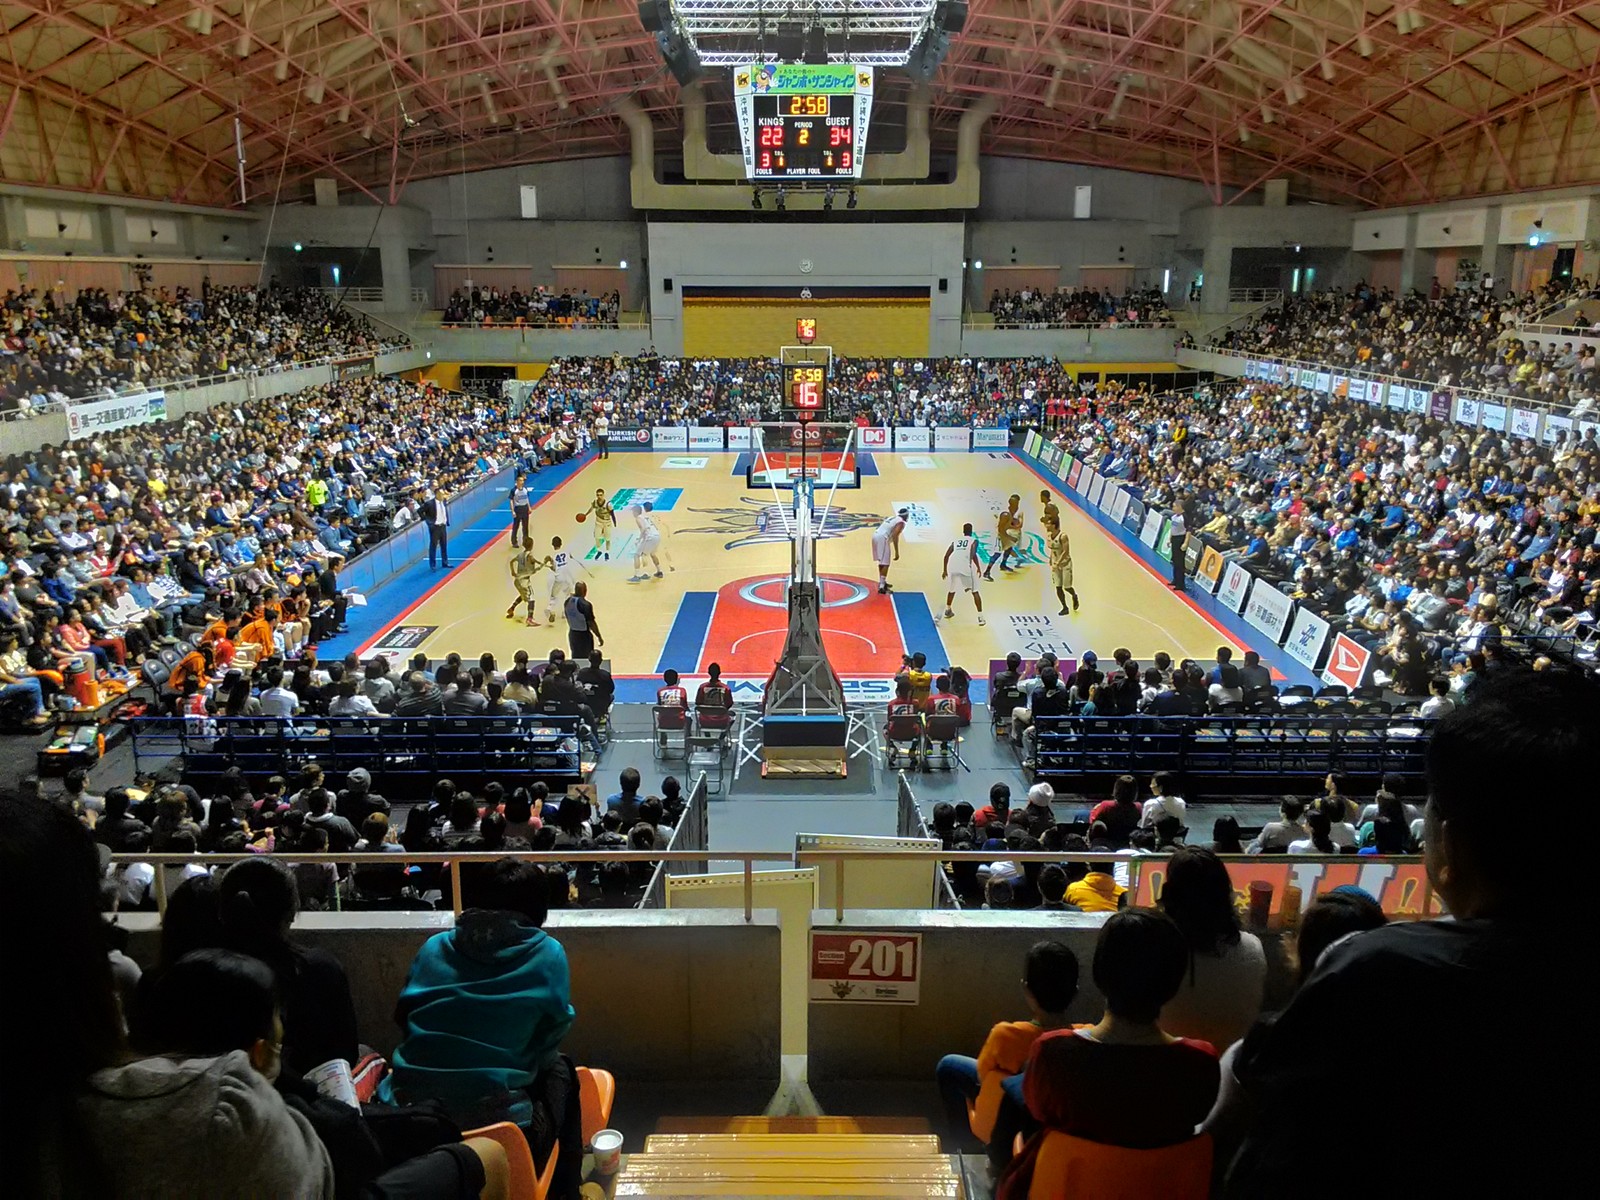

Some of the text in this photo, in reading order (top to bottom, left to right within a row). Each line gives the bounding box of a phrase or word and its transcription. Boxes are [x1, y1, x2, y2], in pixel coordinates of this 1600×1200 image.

[791, 96, 827, 114] 2:58
[758, 117, 784, 126] KINGS
[825, 117, 850, 126] GUEST
[761, 127, 783, 146] 22
[799, 128, 809, 145] 2
[830, 127, 851, 146] 34
[761, 152, 770, 168] 3
[842, 152, 851, 168] 3
[803, 326, 813, 337] 16
[794, 368, 822, 382] 2:58
[799, 382, 818, 406] 16
[865, 430, 884, 442] DC
[956, 539, 969, 548] 30
[848, 939, 914, 977] 201
